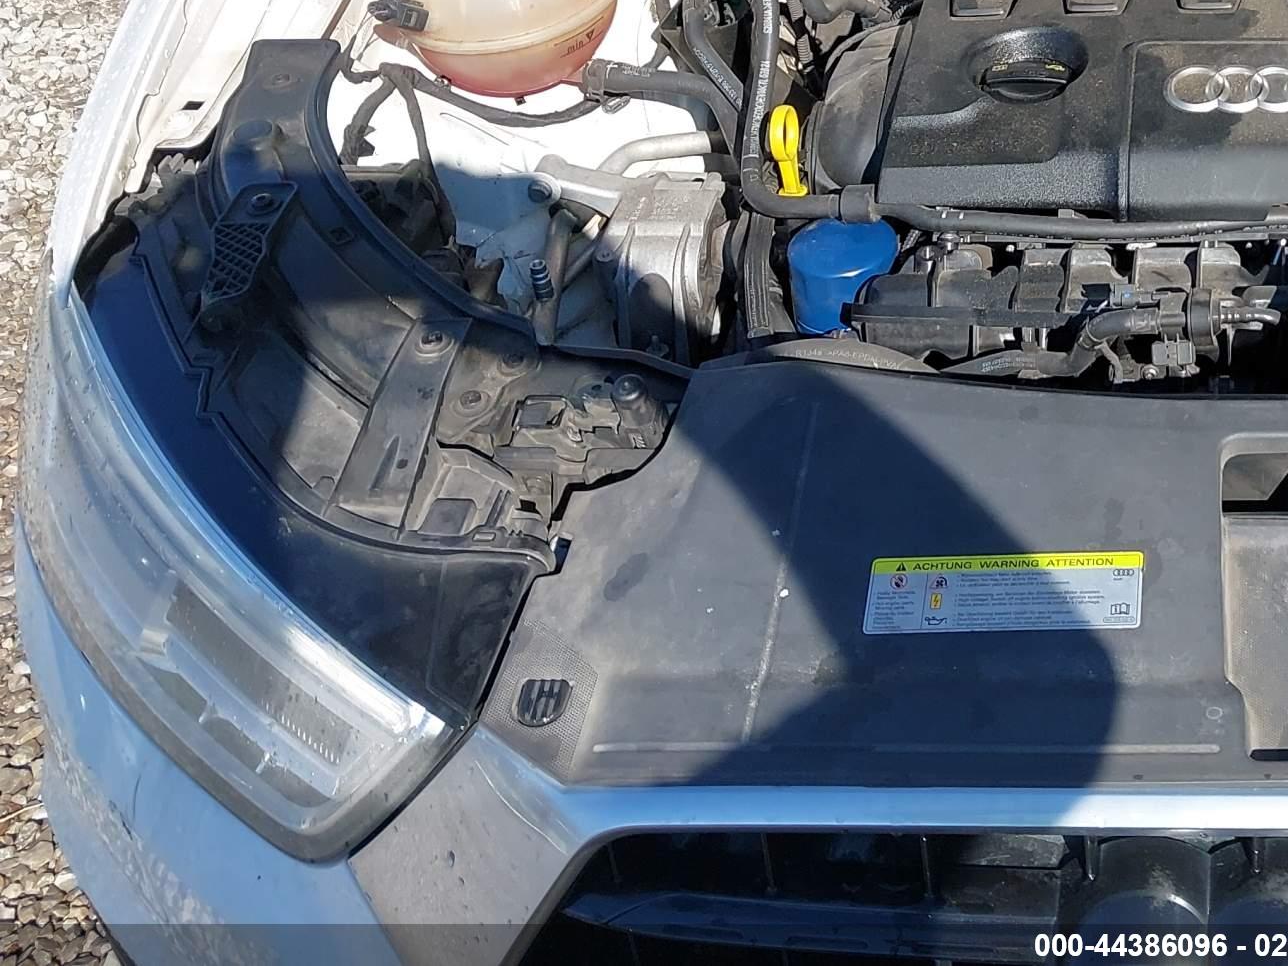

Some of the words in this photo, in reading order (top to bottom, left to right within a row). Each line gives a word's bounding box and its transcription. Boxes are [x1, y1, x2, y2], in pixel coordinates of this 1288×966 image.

[567, 39, 584, 54] min
[912, 561, 972, 571] ACHTUNG
[979, 559, 1040, 569] WARNING
[1046, 557, 1114, 567] ATTENTION
